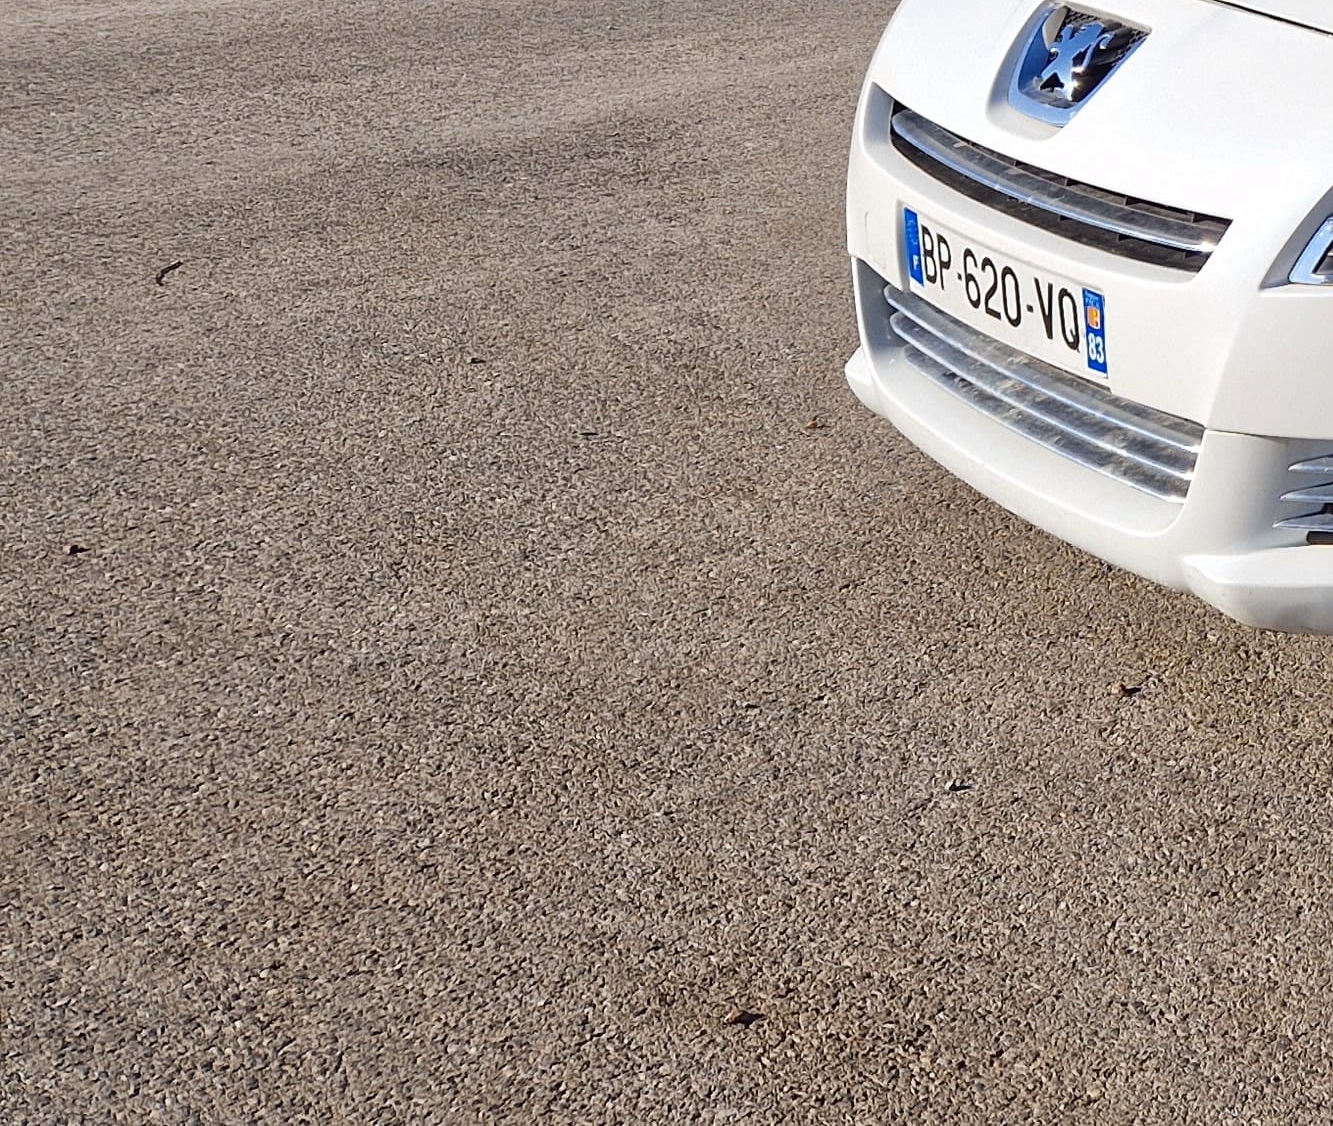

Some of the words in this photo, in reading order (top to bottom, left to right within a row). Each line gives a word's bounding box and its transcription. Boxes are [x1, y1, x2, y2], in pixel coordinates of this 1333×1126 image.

[912, 254, 919, 271] F
[921, 224, 1080, 354] BP-620-VQ
[1087, 332, 1105, 364] 83
